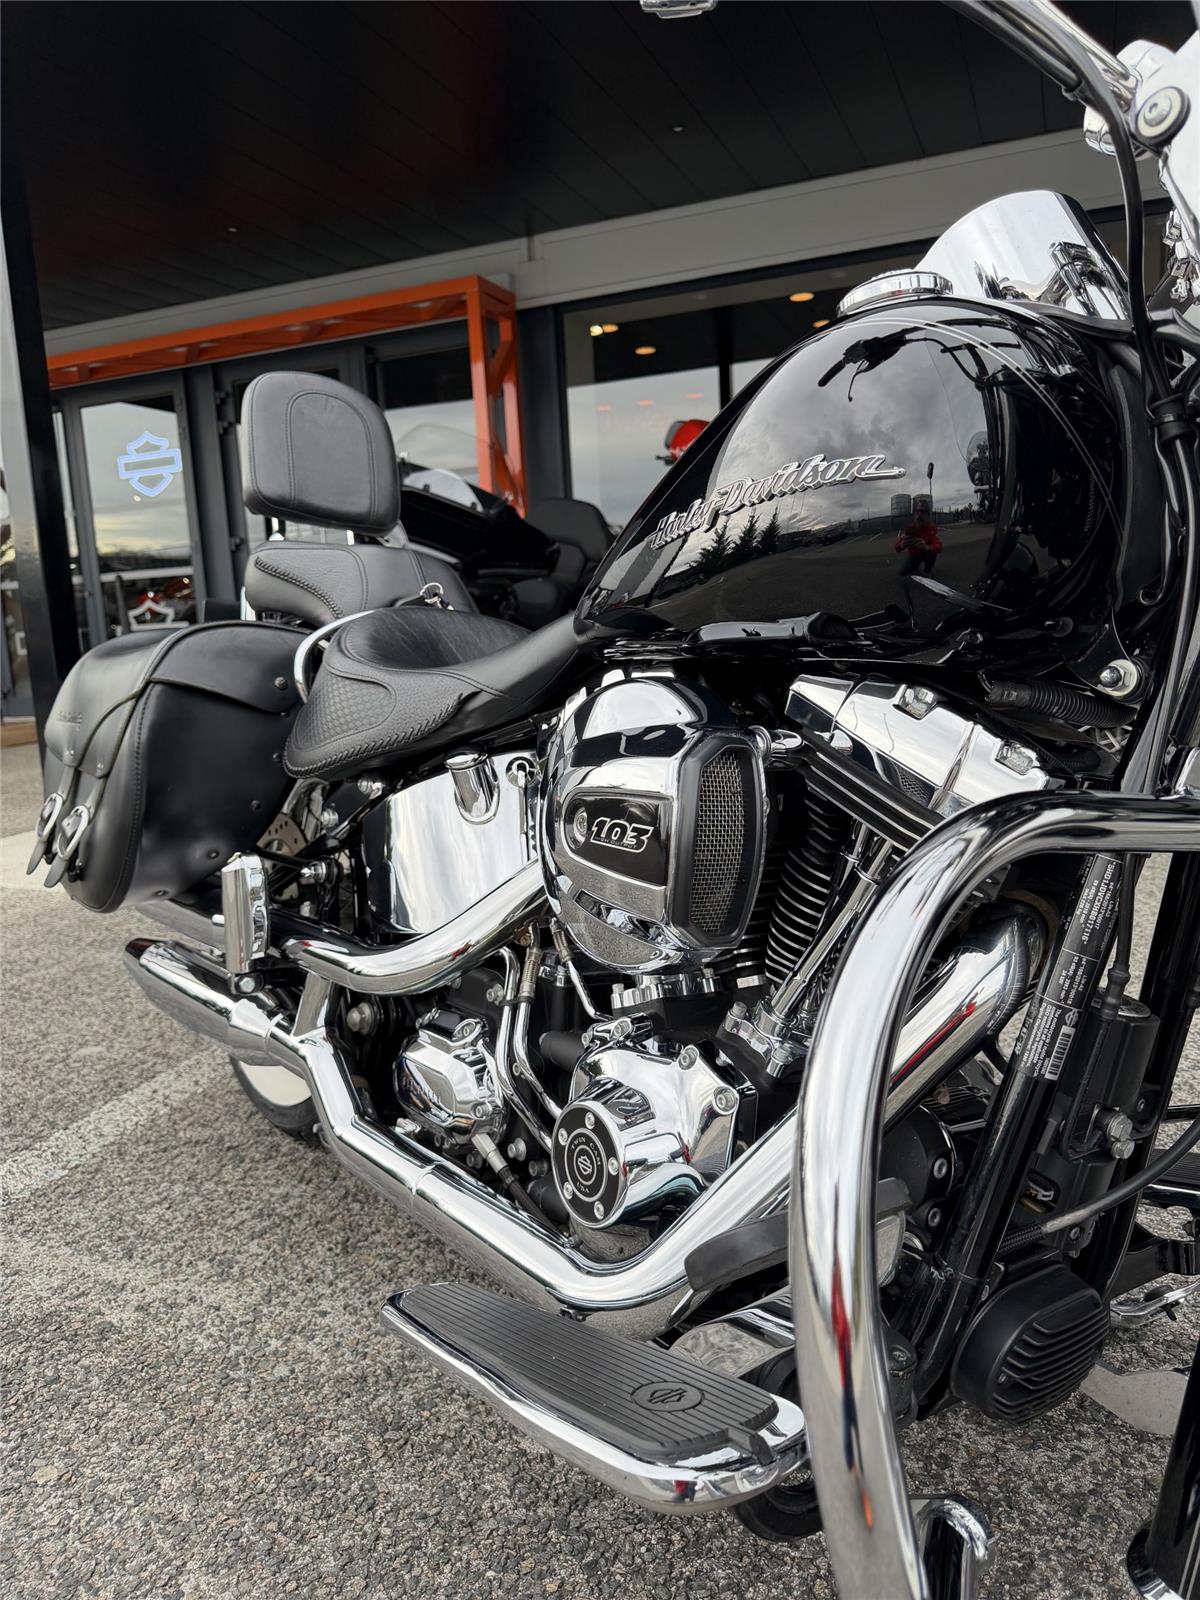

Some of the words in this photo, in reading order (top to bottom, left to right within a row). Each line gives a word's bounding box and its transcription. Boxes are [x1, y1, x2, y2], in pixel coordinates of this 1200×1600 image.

[644, 453, 906, 549] Harley-Davidson
[590, 817, 654, 853] 103
[610, 840, 638, 849] OUTPUT
[571, 1136, 586, 1149] TWIN
[589, 1142, 600, 1165] CAM
[576, 1181, 590, 1193] USA
